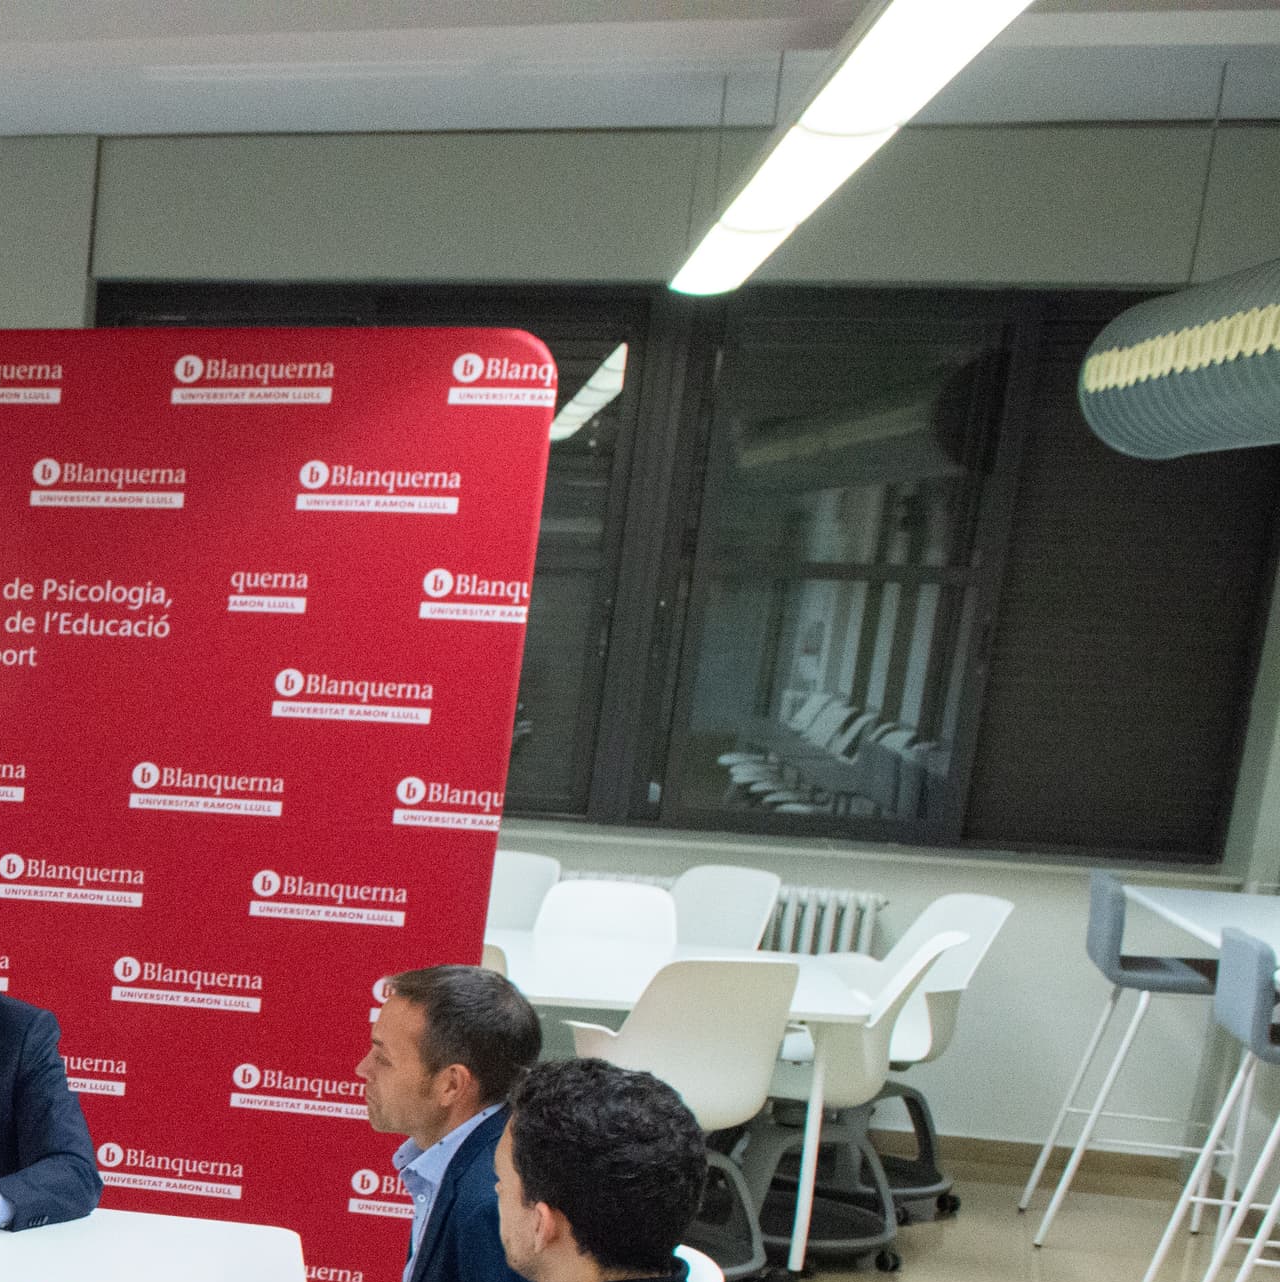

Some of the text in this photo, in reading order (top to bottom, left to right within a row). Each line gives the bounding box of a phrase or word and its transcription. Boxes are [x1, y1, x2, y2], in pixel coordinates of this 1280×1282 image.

[204, 360, 334, 384] Blanquerna
[61, 464, 185, 489] Blanquerna
[329, 464, 461, 492] Blanquerna
[3, 578, 34, 600] de
[42, 578, 173, 610] Psicologia,
[5, 611, 36, 633] de
[43, 611, 171, 637] l'Educació
[304, 673, 433, 702] Blanquerna
[281, 705, 421, 720] UNIVERSITAT RAMON LLULL
[160, 767, 283, 795] Blanquerna
[137, 798, 273, 813] UNIVERSITAT RAMON LLULL
[403, 814, 467, 825] UNIVERSITAT
[25, 859, 144, 886] Blanquerna
[4, 888, 134, 904] UNIVERSITAT RAMON LLULL
[280, 874, 406, 904] Blanquerna
[258, 905, 396, 923] UNIVERSITAT RAMON LLULL
[141, 962, 262, 990] Blanquerna
[119, 991, 252, 1009] UNIVERSITAT RAMON LLULL
[239, 1098, 342, 1113] UNIVERSITAT RAMON
[126, 1149, 242, 1177] Blanquerna
[102, 1175, 232, 1196] UNIVERSITAT RAMON LLULL
[358, 1203, 414, 1215] UNIVERSITA
